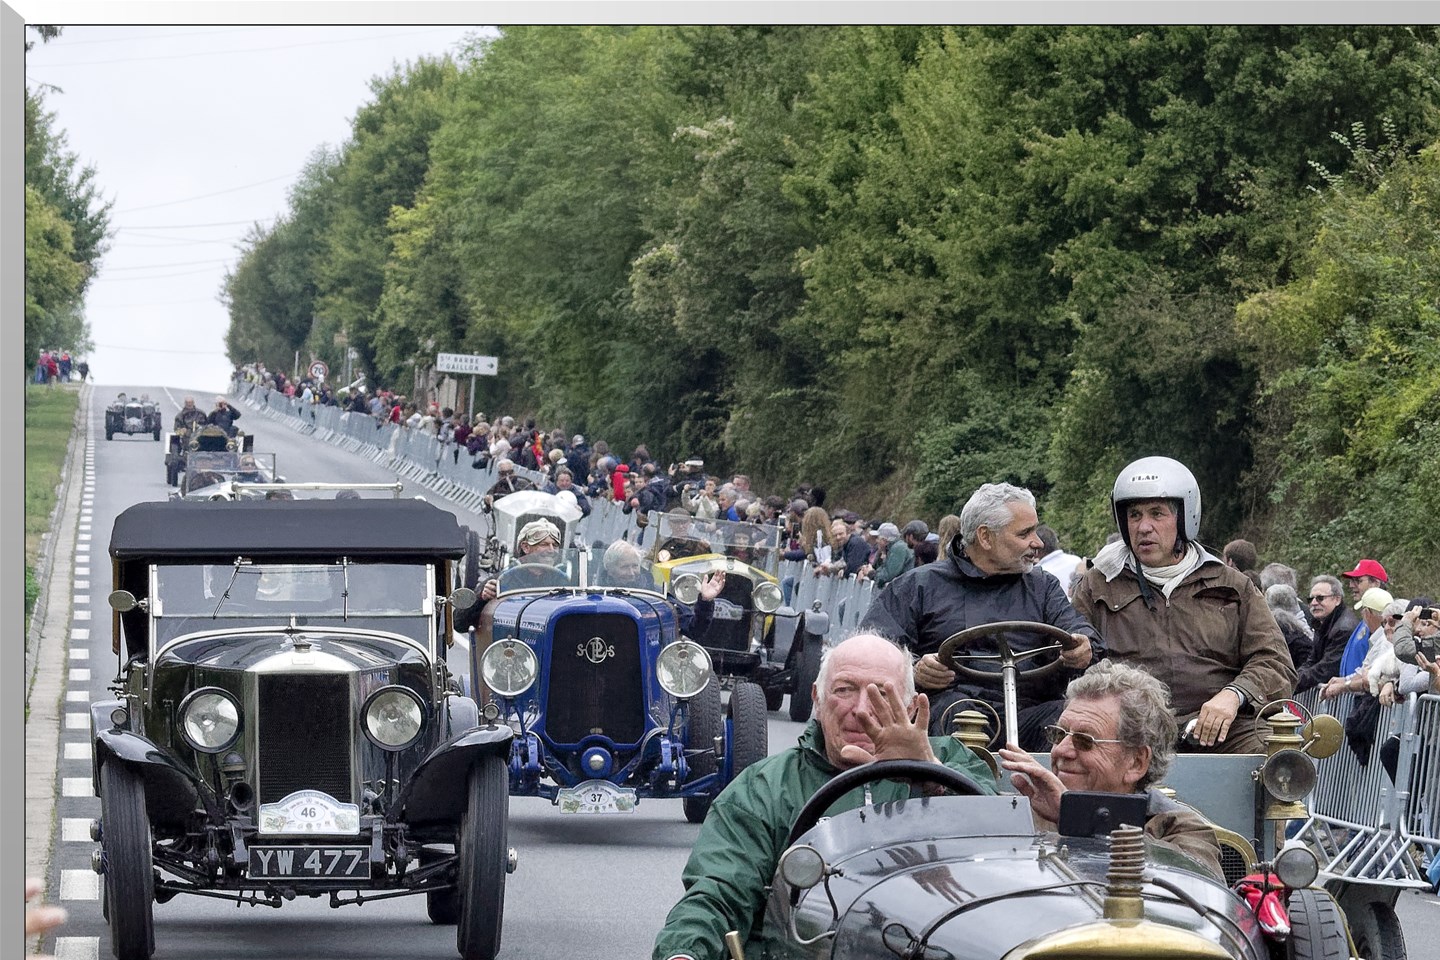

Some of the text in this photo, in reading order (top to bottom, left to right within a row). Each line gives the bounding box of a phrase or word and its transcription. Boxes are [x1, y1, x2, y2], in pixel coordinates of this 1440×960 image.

[314, 366, 323, 374] 70
[590, 793, 603, 803] 37
[300, 807, 316, 818] 46
[256, 849, 363, 875] YW 477
